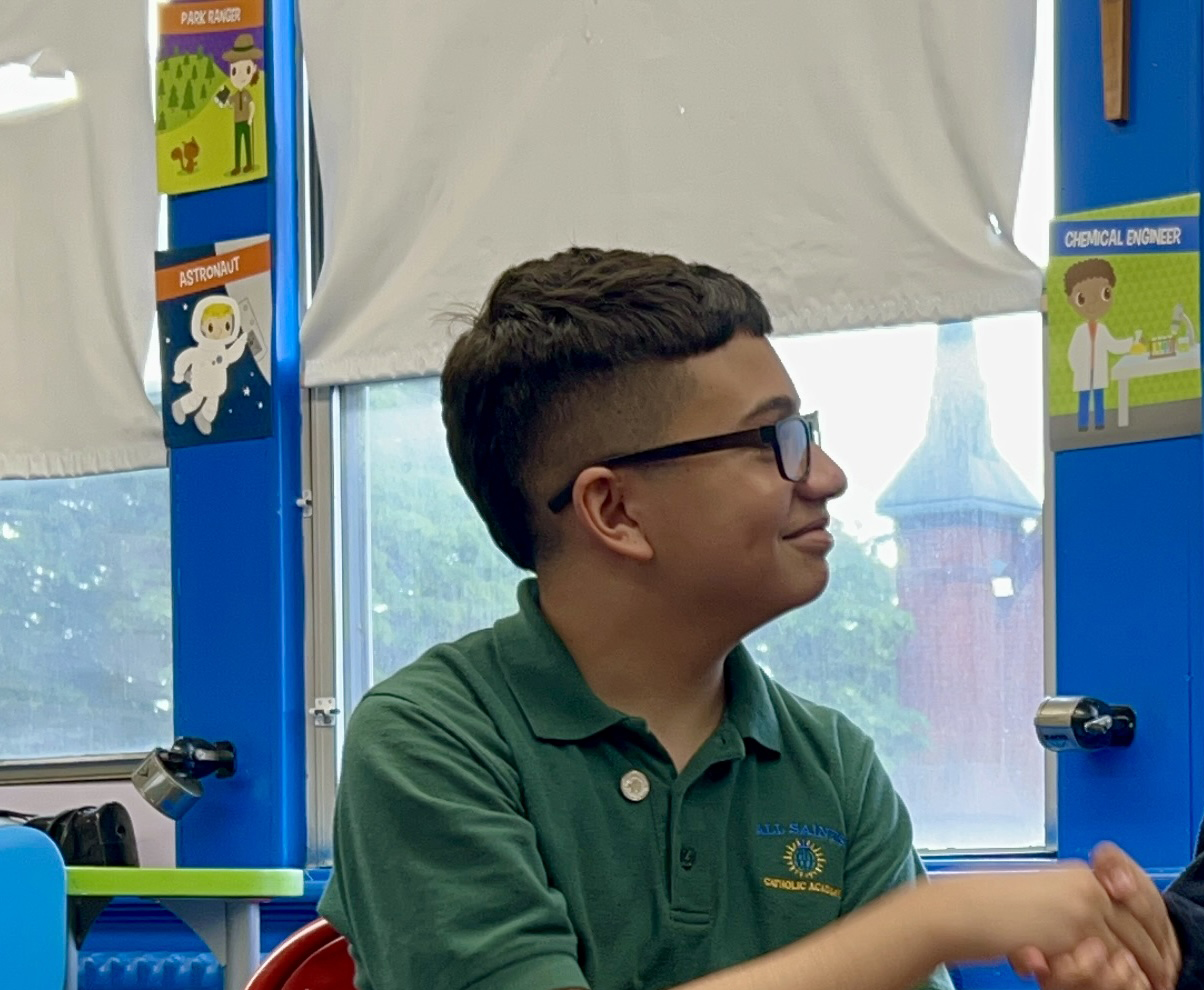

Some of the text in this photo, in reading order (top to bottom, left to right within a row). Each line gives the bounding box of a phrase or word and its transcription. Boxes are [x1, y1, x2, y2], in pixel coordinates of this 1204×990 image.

[181, 7, 241, 25] PARK RANGER
[1064, 227, 1182, 248] CHEMICAL ENGINEER
[179, 255, 240, 288] ASTRONAUT
[756, 822, 785, 836] ALL
[763, 876, 807, 891] CATHOLIC
